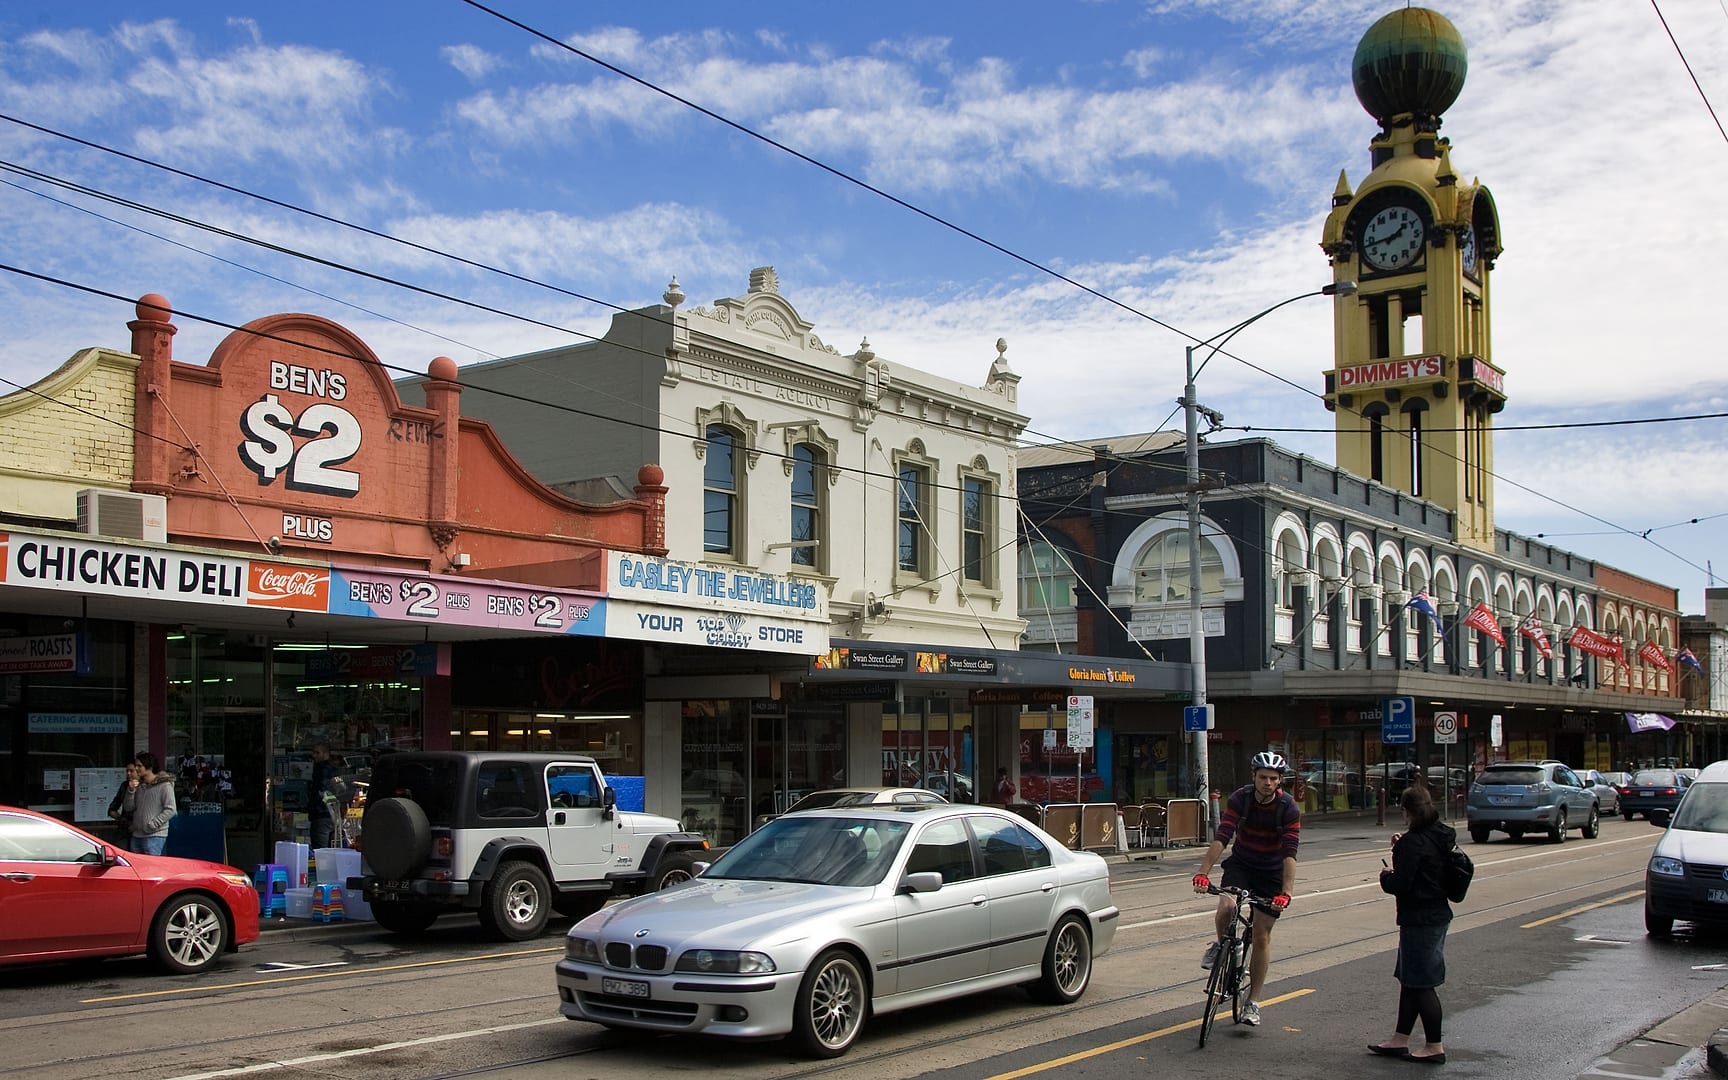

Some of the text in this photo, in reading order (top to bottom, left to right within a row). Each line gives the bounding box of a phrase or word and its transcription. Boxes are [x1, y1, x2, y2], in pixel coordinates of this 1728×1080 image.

[270, 360, 347, 401] BEN'S
[1340, 357, 1440, 386] DIMMEY'S
[700, 366, 832, 411] ESTATE AGENCY
[239, 394, 362, 497] $2
[282, 514, 333, 540] PLUS
[17, 542, 242, 598] CHICKEN DELI
[619, 559, 816, 610] CASLEY THE JEWELLERS
[350, 579, 590, 629] BEN'S $2 PLUS BEN'S $2 PLUS
[637, 613, 803, 644] YOUR STORE
[697, 616, 726, 632] TOP
[30, 637, 73, 657] ROASTS
[706, 630, 752, 648] CARAT
[852, 653, 905, 665] Swan Street Gallery
[949, 660, 962, 668] Swan
[962, 661, 978, 669] Street
[977, 662, 994, 671] Gallery
[1069, 667, 1136, 683] Gloria Jean's Coffees
[31, 715, 123, 724] CATERING AVAILABLE
[1192, 709, 1199, 717] P
[1360, 709, 1382, 720] nab
[1389, 699, 1406, 722] P
[1438, 719, 1454, 730] 40
[1069, 734, 1079, 742] 2P
